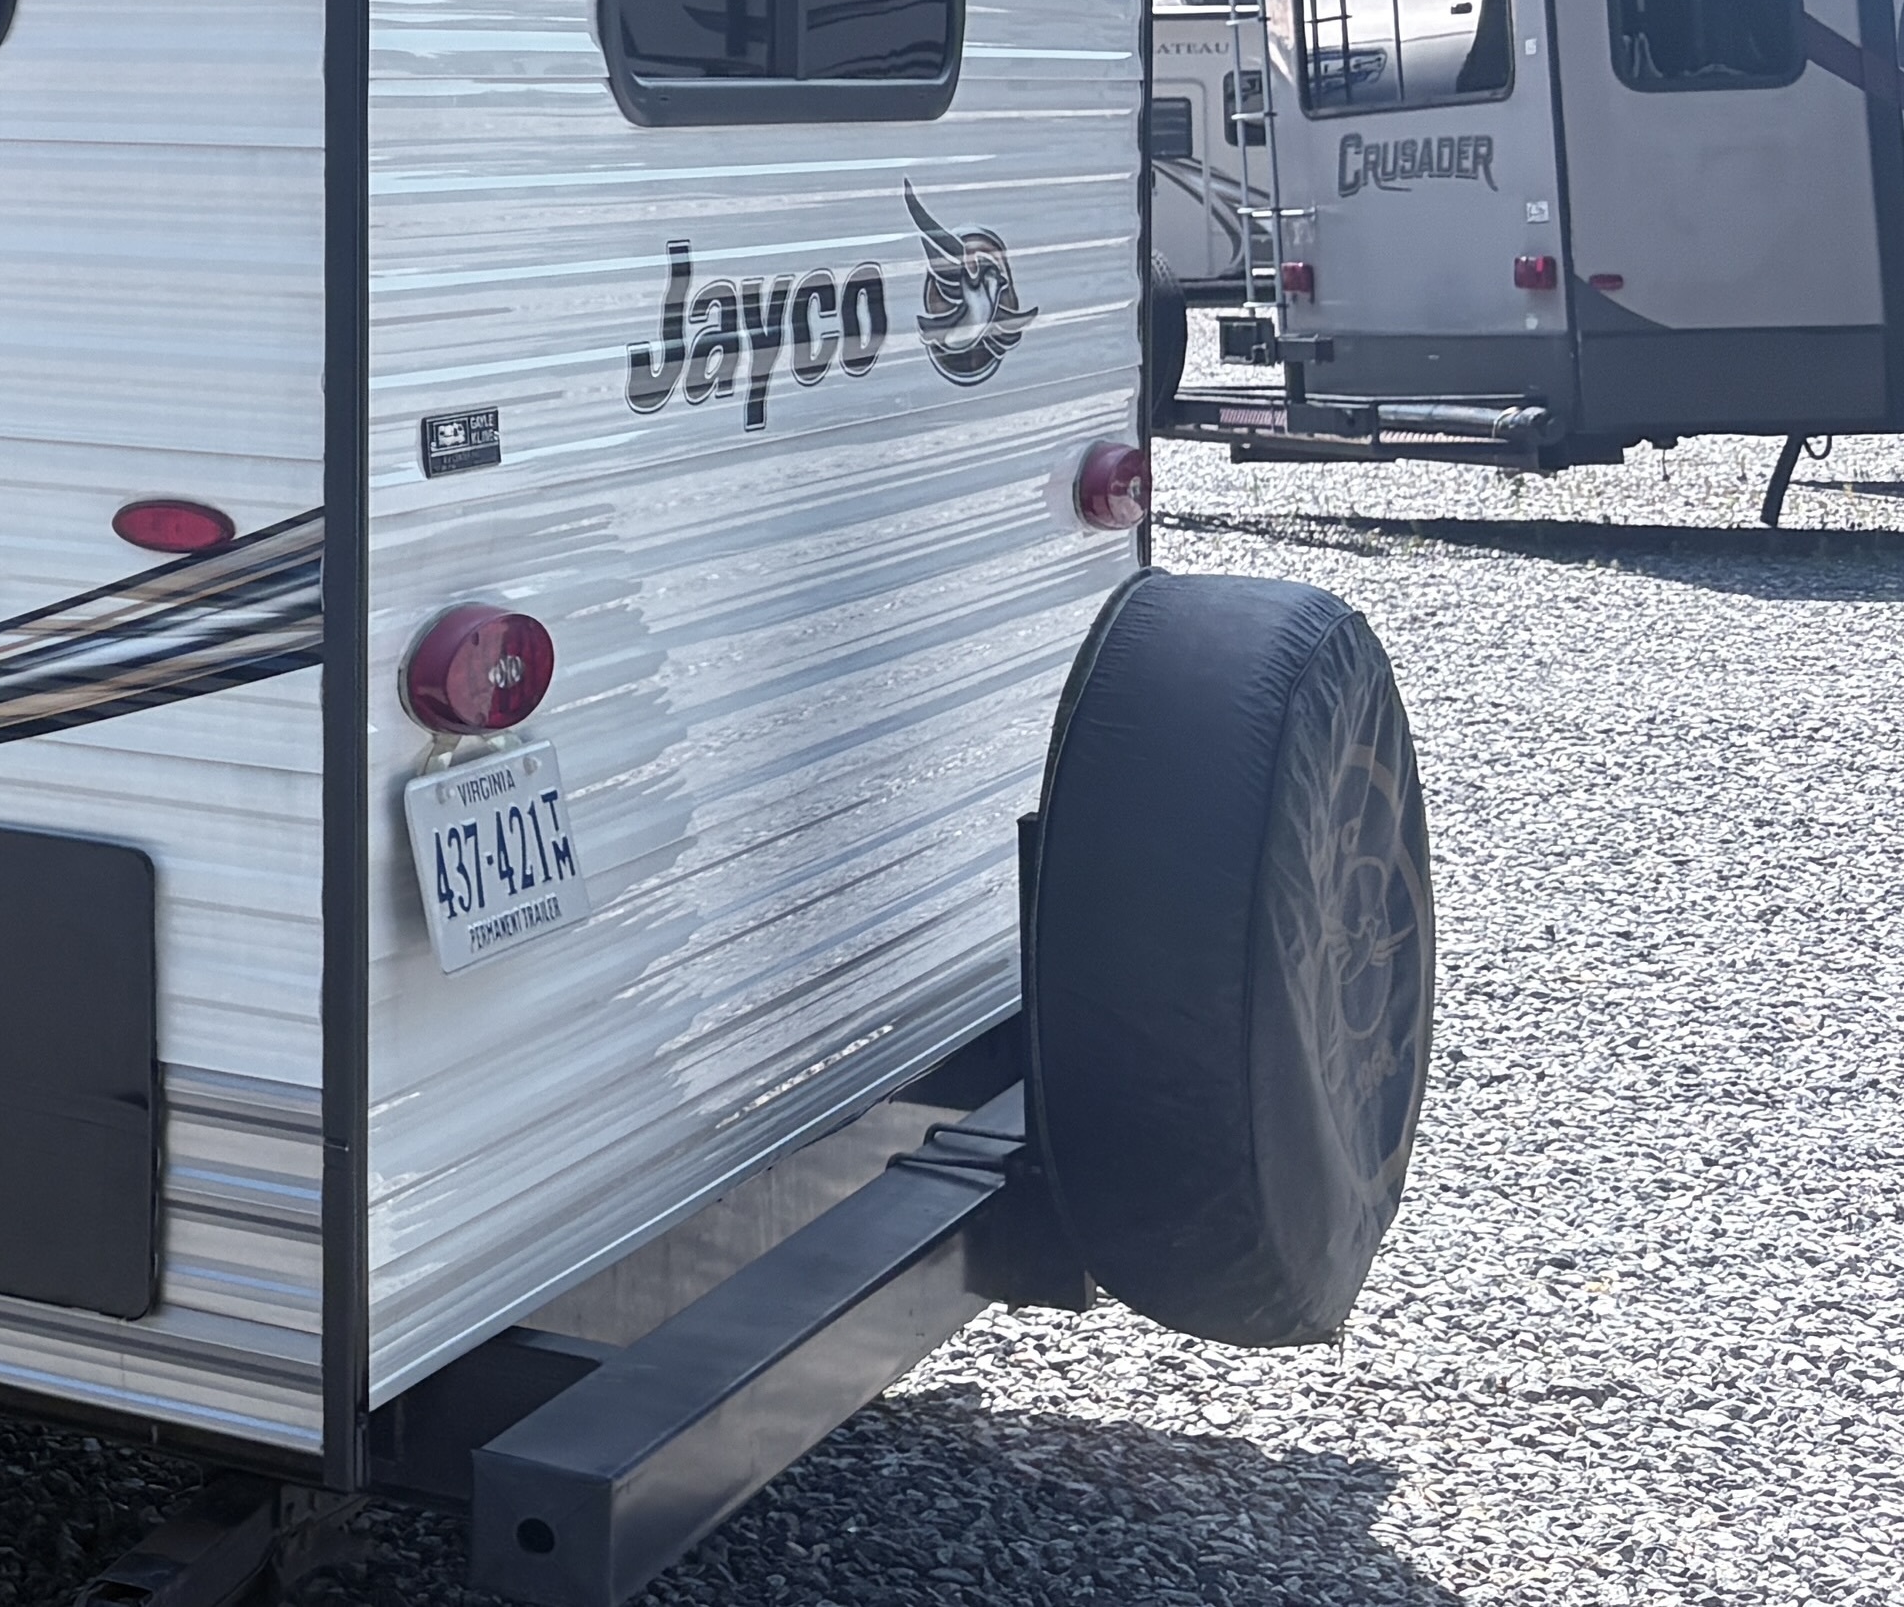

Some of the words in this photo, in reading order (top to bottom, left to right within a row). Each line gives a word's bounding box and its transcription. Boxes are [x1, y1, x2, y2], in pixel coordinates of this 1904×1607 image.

[1338, 132, 1500, 198] CRUSADER
[625, 239, 888, 432] Jayco
[457, 768, 516, 806] VIRGINIA
[434, 799, 553, 920] 437-421
[468, 906, 524, 954] PERMANENT
[521, 894, 563, 930] TRAILER
